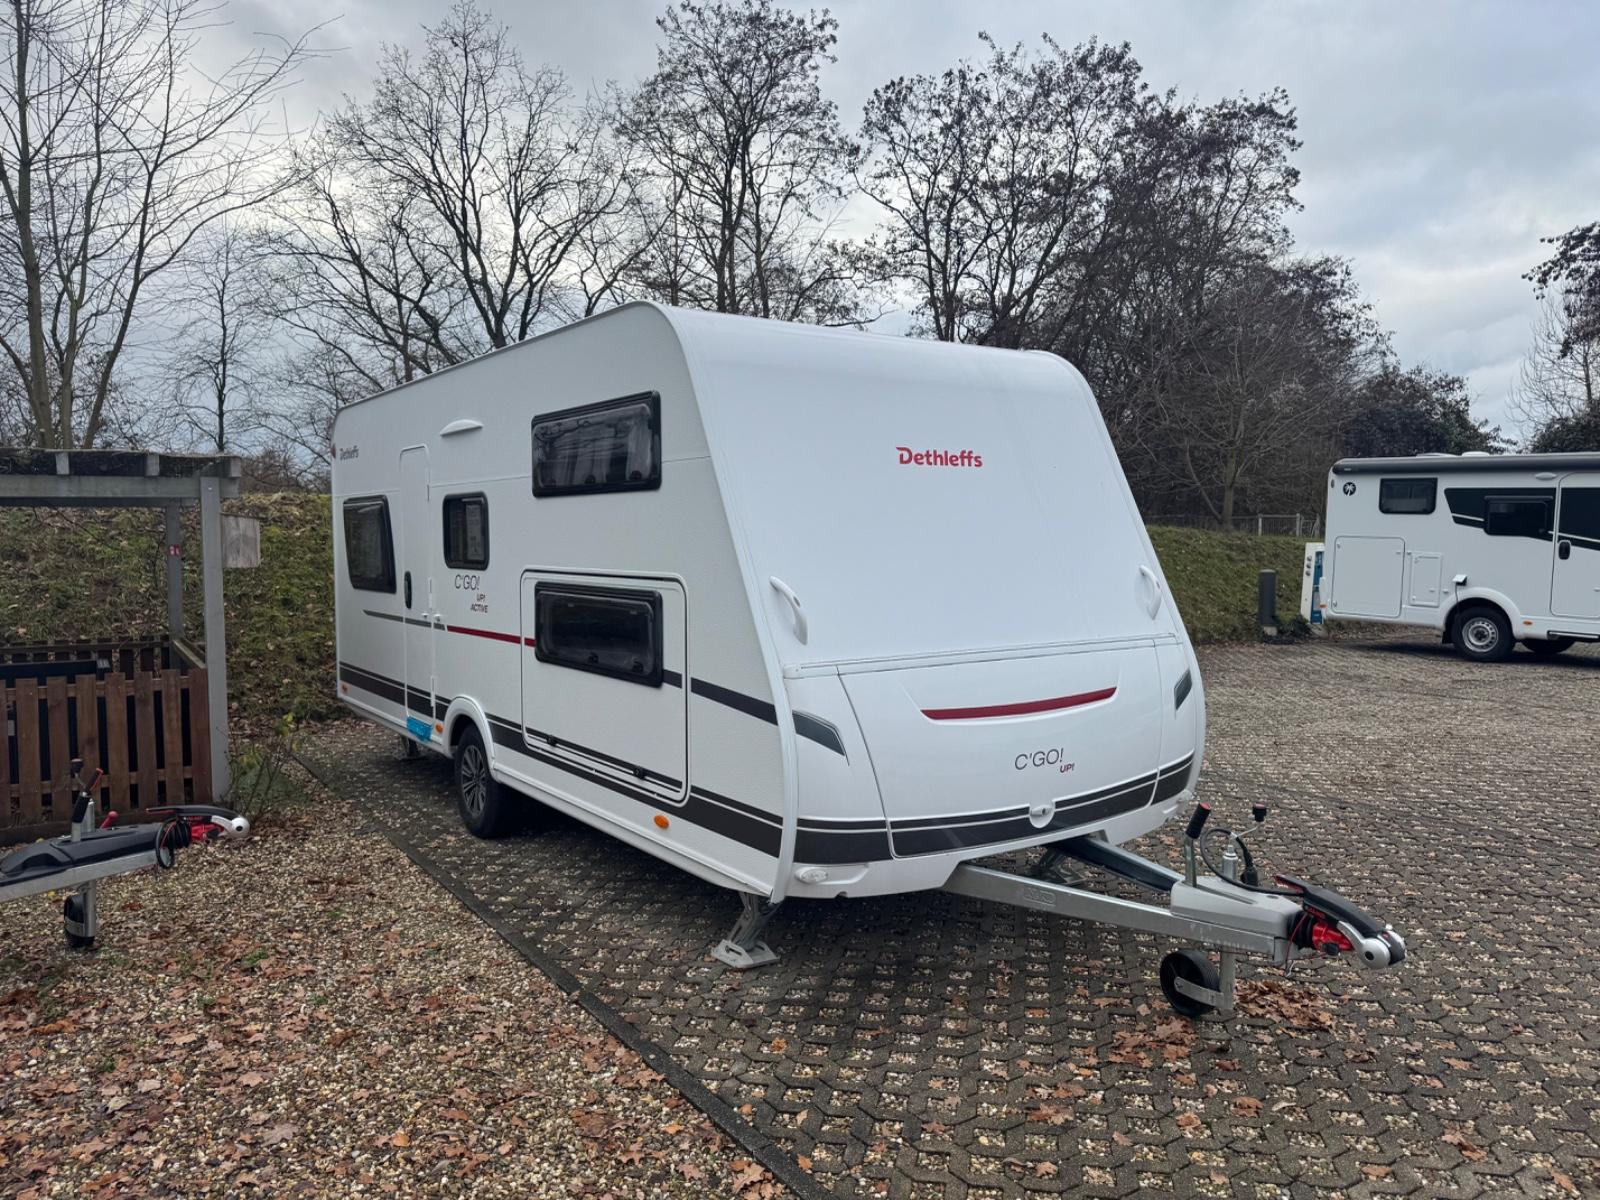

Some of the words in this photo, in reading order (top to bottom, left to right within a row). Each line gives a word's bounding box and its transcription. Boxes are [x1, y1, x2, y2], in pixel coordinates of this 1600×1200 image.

[895, 446, 983, 468] Dethleffs
[455, 574, 480, 590] C'GO!
[1014, 747, 1064, 770] C'GO!
[1060, 763, 1075, 773] UP!
